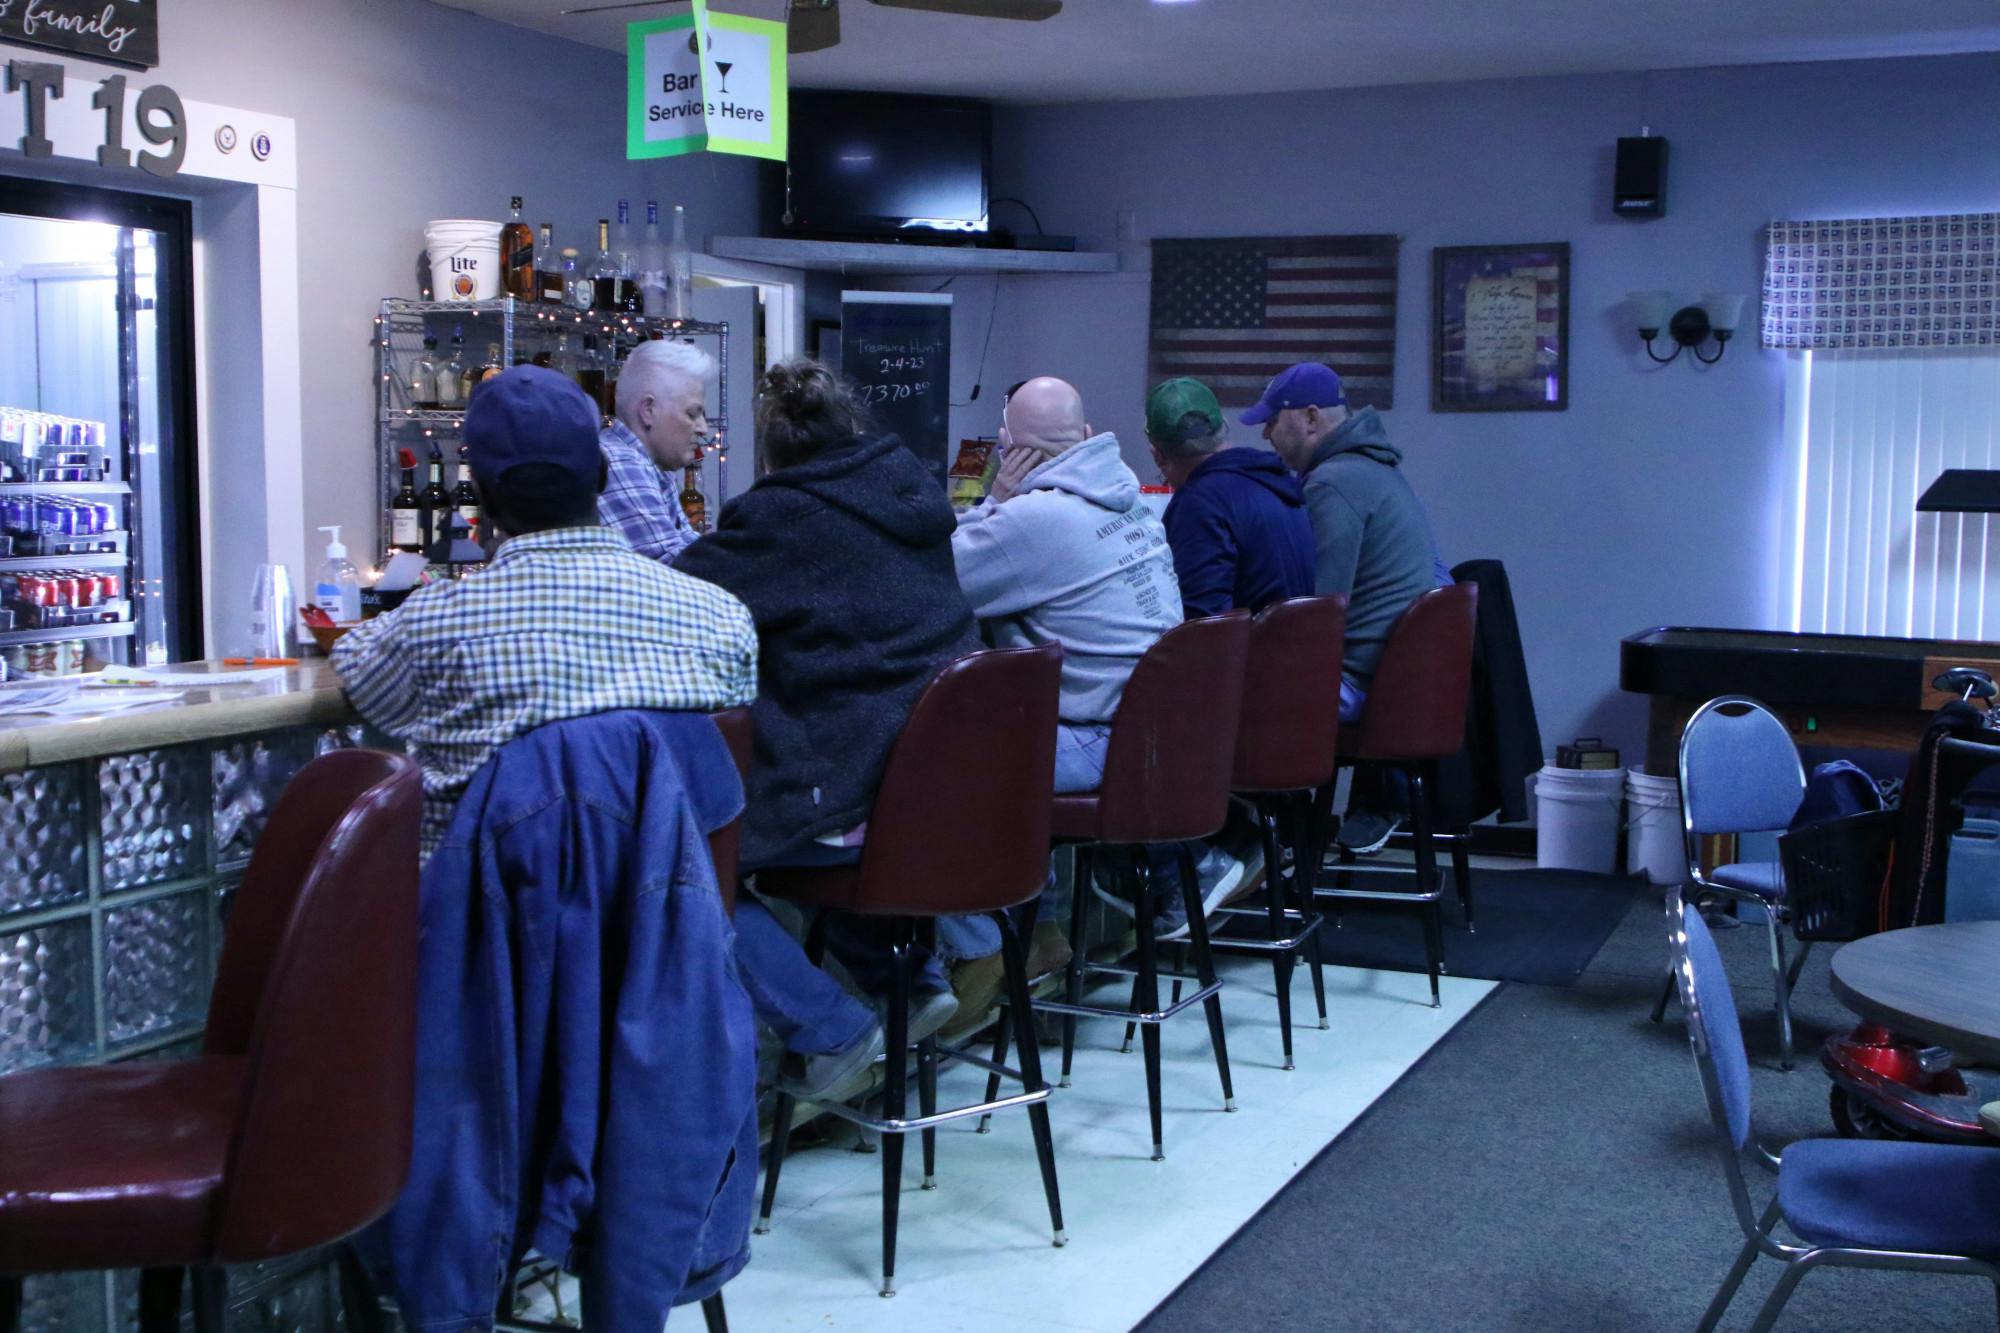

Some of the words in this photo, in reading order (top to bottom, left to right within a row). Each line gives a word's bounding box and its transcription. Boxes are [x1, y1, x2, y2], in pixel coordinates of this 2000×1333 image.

[24, 0, 137, 52] family
[663, 73, 698, 92] Bar
[649, 101, 715, 121] Service
[721, 102, 765, 122] Here
[92, 74, 187, 177] 19
[451, 256, 478, 273] Lite
[909, 338, 944, 353] Hunt
[880, 357, 925, 373] 2-4-23
